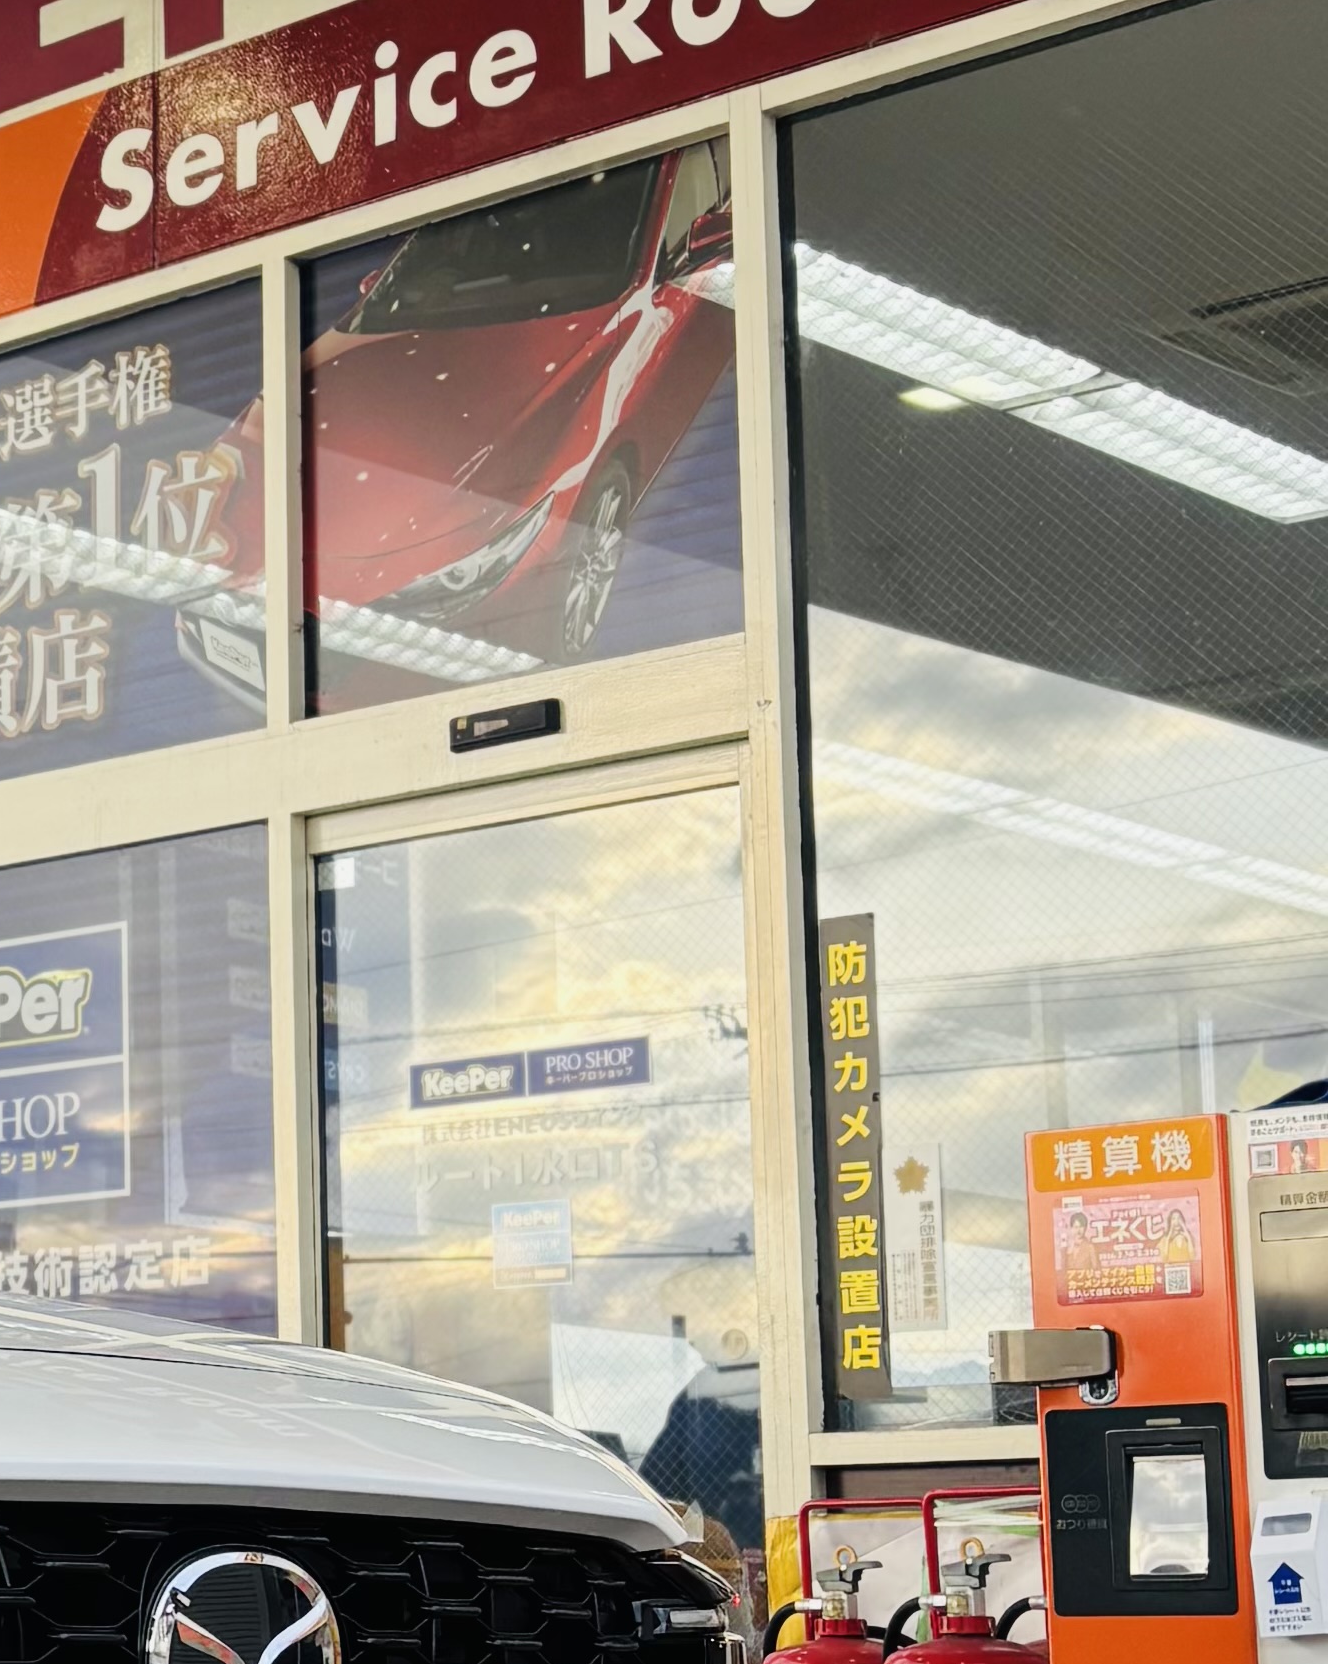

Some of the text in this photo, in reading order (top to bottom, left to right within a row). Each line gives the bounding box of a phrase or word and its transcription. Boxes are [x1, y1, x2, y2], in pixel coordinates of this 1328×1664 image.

[96, 29, 537, 232] Service
[422, 1065, 513, 1099] KeePer
[545, 1047, 634, 1074] PRO SHOP
[827, 940, 882, 1370] 防犯カメラ設置店
[1054, 1129, 1192, 1182] 精算機
